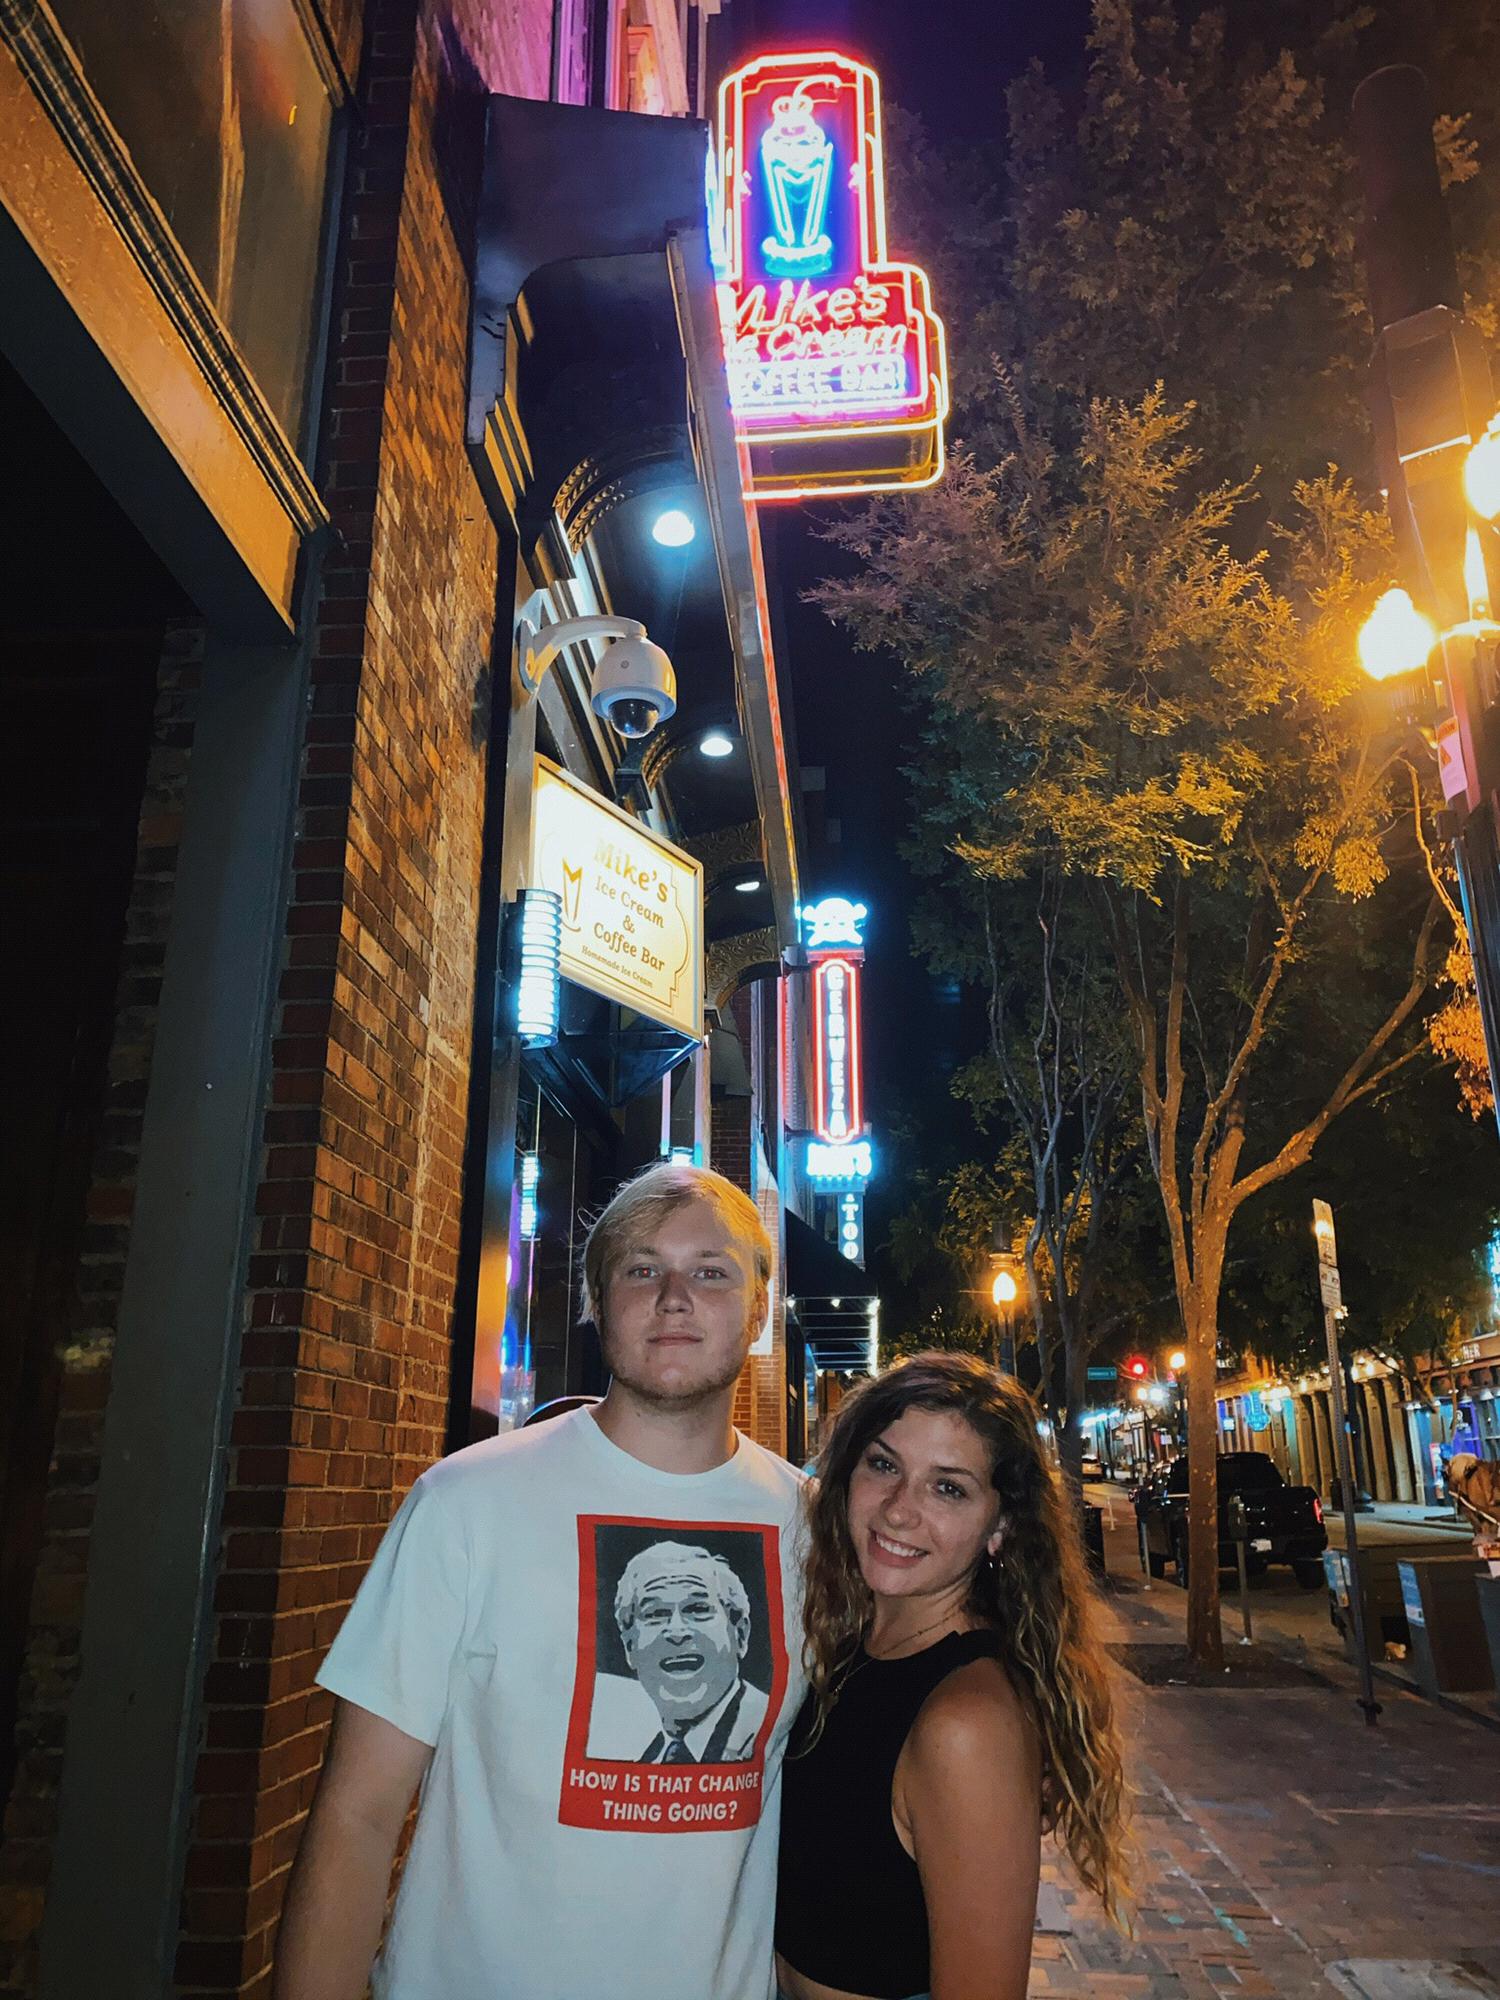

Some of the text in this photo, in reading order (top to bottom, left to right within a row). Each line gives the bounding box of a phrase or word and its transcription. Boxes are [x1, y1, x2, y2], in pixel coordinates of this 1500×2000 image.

[594, 840, 668, 903] Mike's
[595, 875, 664, 929] Ice Cream
[623, 914, 635, 934] &
[581, 944, 654, 989] Homemade Ice Cream
[593, 922, 665, 972] Coffee Bar
[570, 1768, 760, 1793] HOW IS THAT CHANGE
[602, 1800, 738, 1822] THING GOING?
